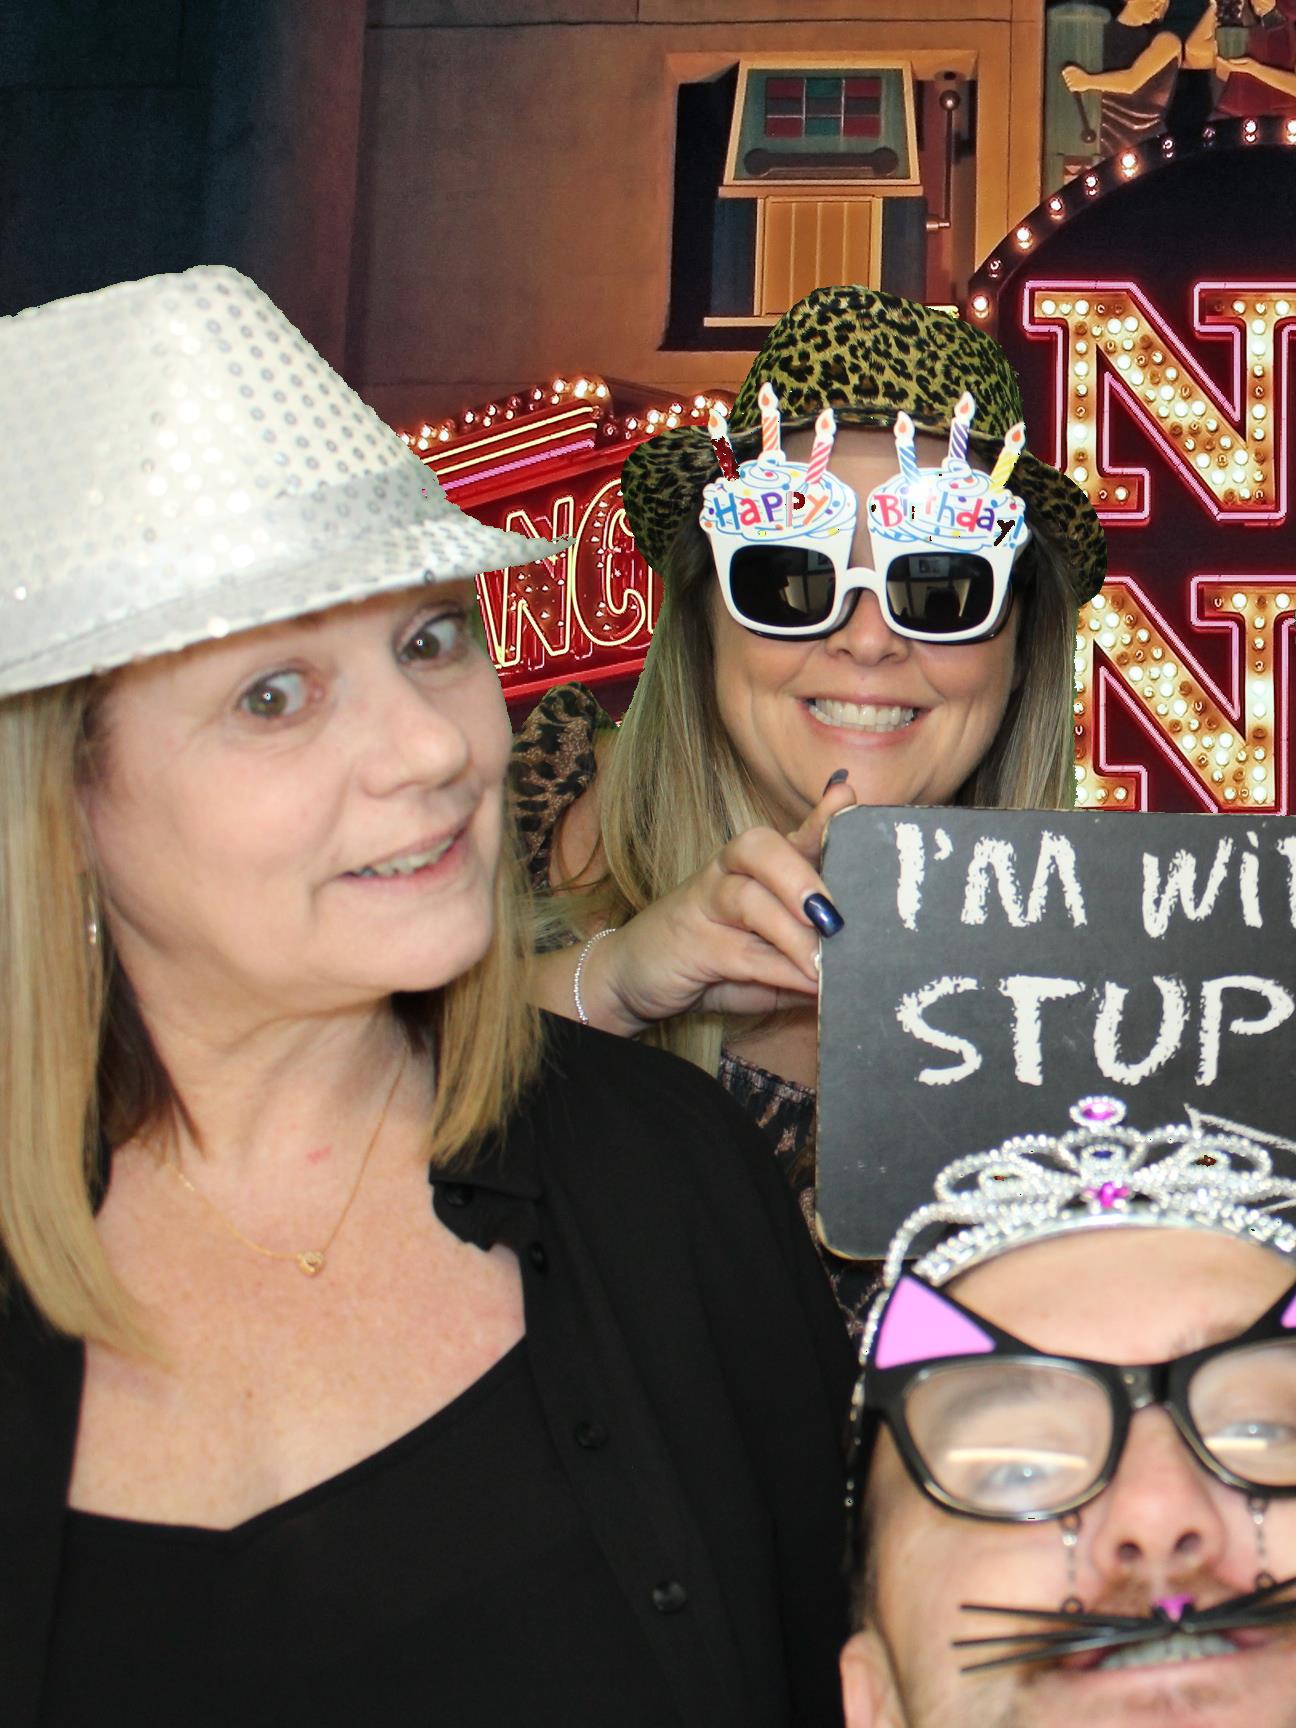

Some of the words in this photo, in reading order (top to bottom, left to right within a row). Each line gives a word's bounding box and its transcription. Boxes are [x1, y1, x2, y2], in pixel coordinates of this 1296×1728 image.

[713, 491, 829, 531] Happy
[873, 490, 1025, 549] Bithday!
[893, 820, 1088, 933] I'M
